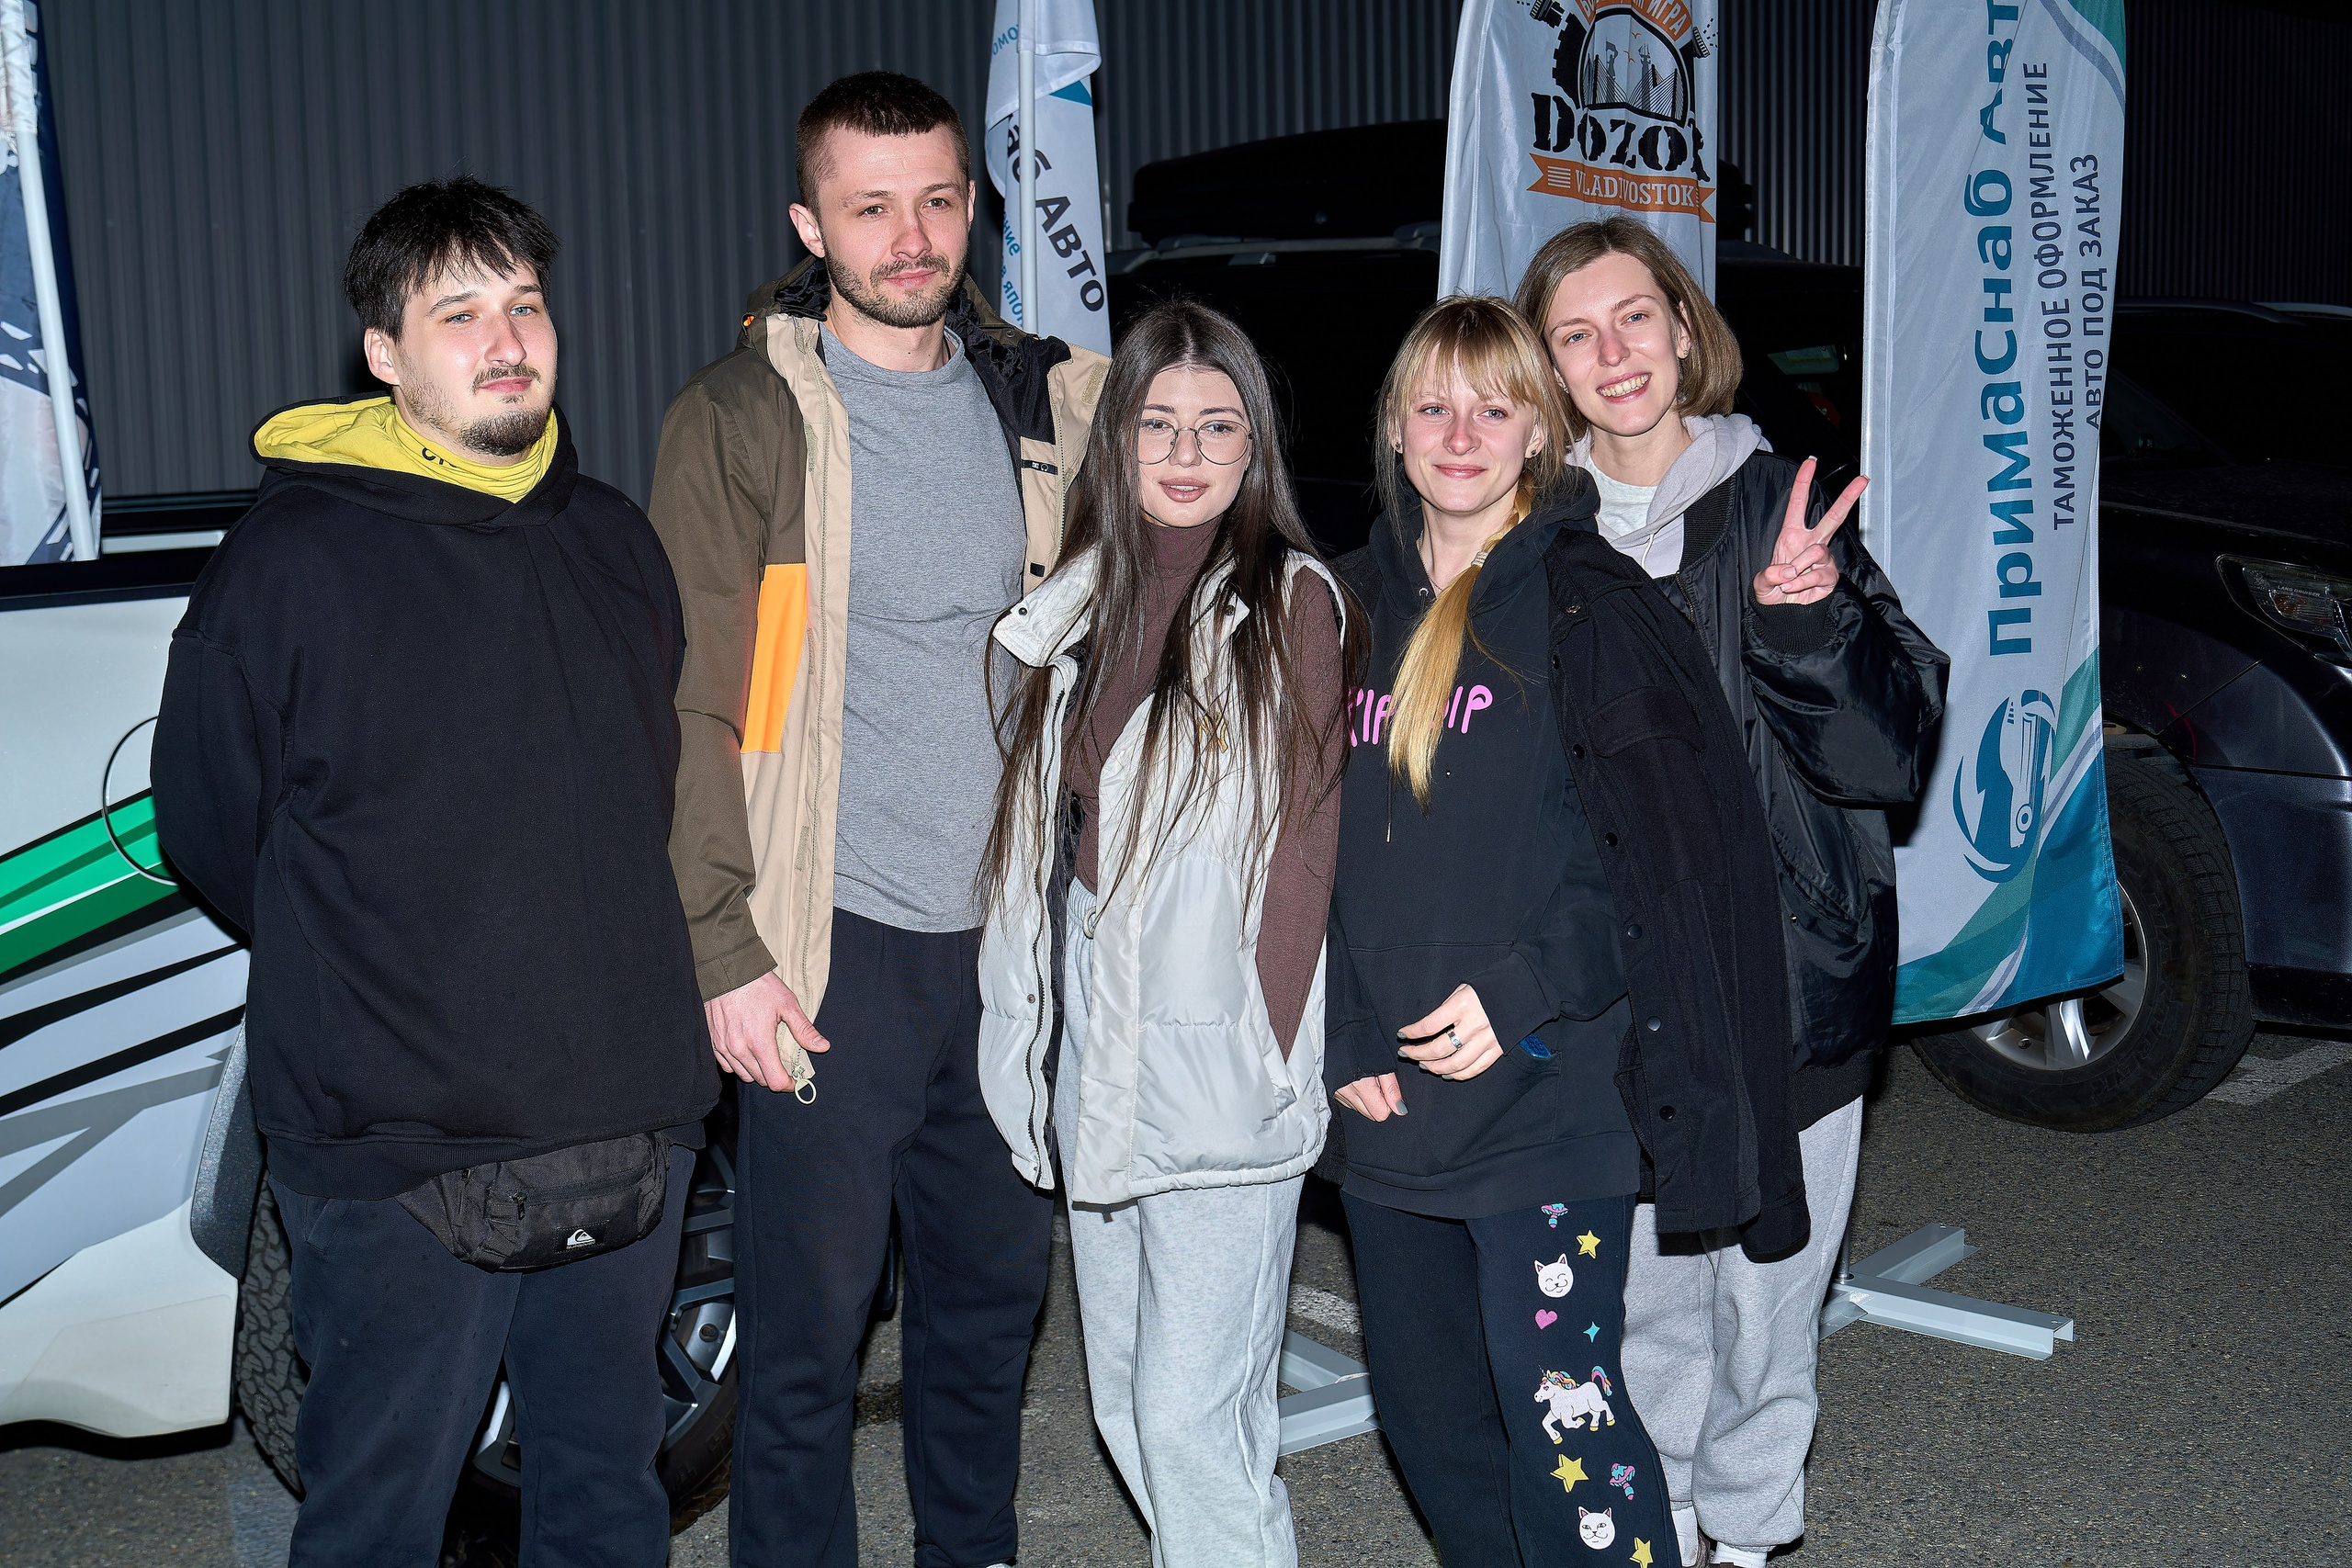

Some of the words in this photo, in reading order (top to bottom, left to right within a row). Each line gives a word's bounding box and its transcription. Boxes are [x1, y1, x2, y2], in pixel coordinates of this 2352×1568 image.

[1531, 93, 1711, 182] DOZOR
[2023, 62, 2066, 289] ОФОРМЛЕНИЕ
[1575, 170, 1696, 208] VLADIVOSTOK
[2069, 153, 2101, 257] ЗАКАЗ
[2079, 267, 2108, 336] ПОД
[2041, 299, 2076, 530] ТАМОЖЕННОЕ
[2084, 349, 2104, 431] АВТО
[2294, 589, 2321, 597] CRUISER
